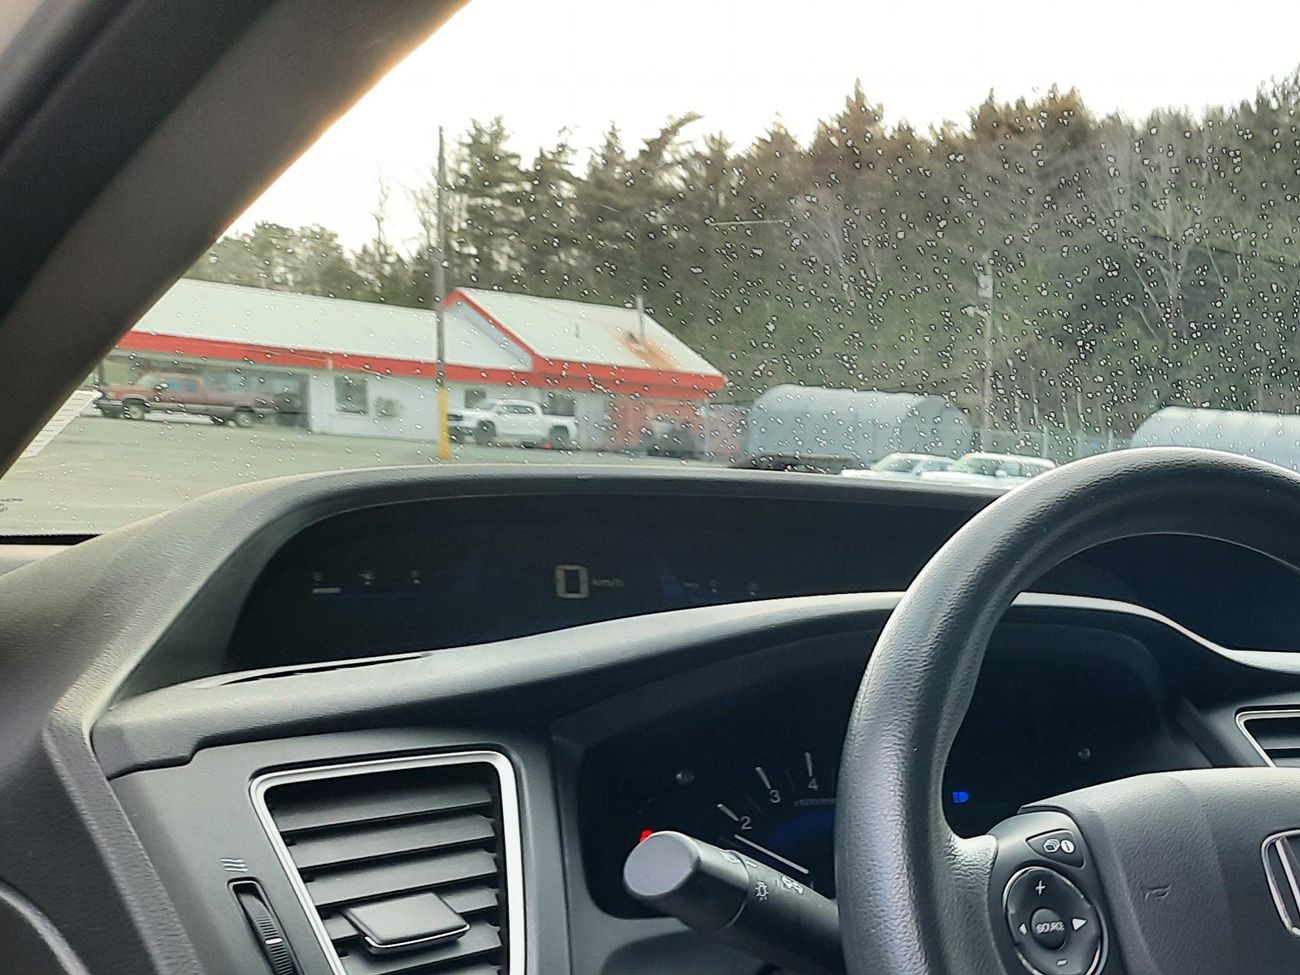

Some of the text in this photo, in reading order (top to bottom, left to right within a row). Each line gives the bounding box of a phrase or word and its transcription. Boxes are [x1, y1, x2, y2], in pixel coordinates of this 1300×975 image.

[808, 778, 818, 791] 4
[769, 789, 781, 803] 3
[740, 815, 753, 830] 2
